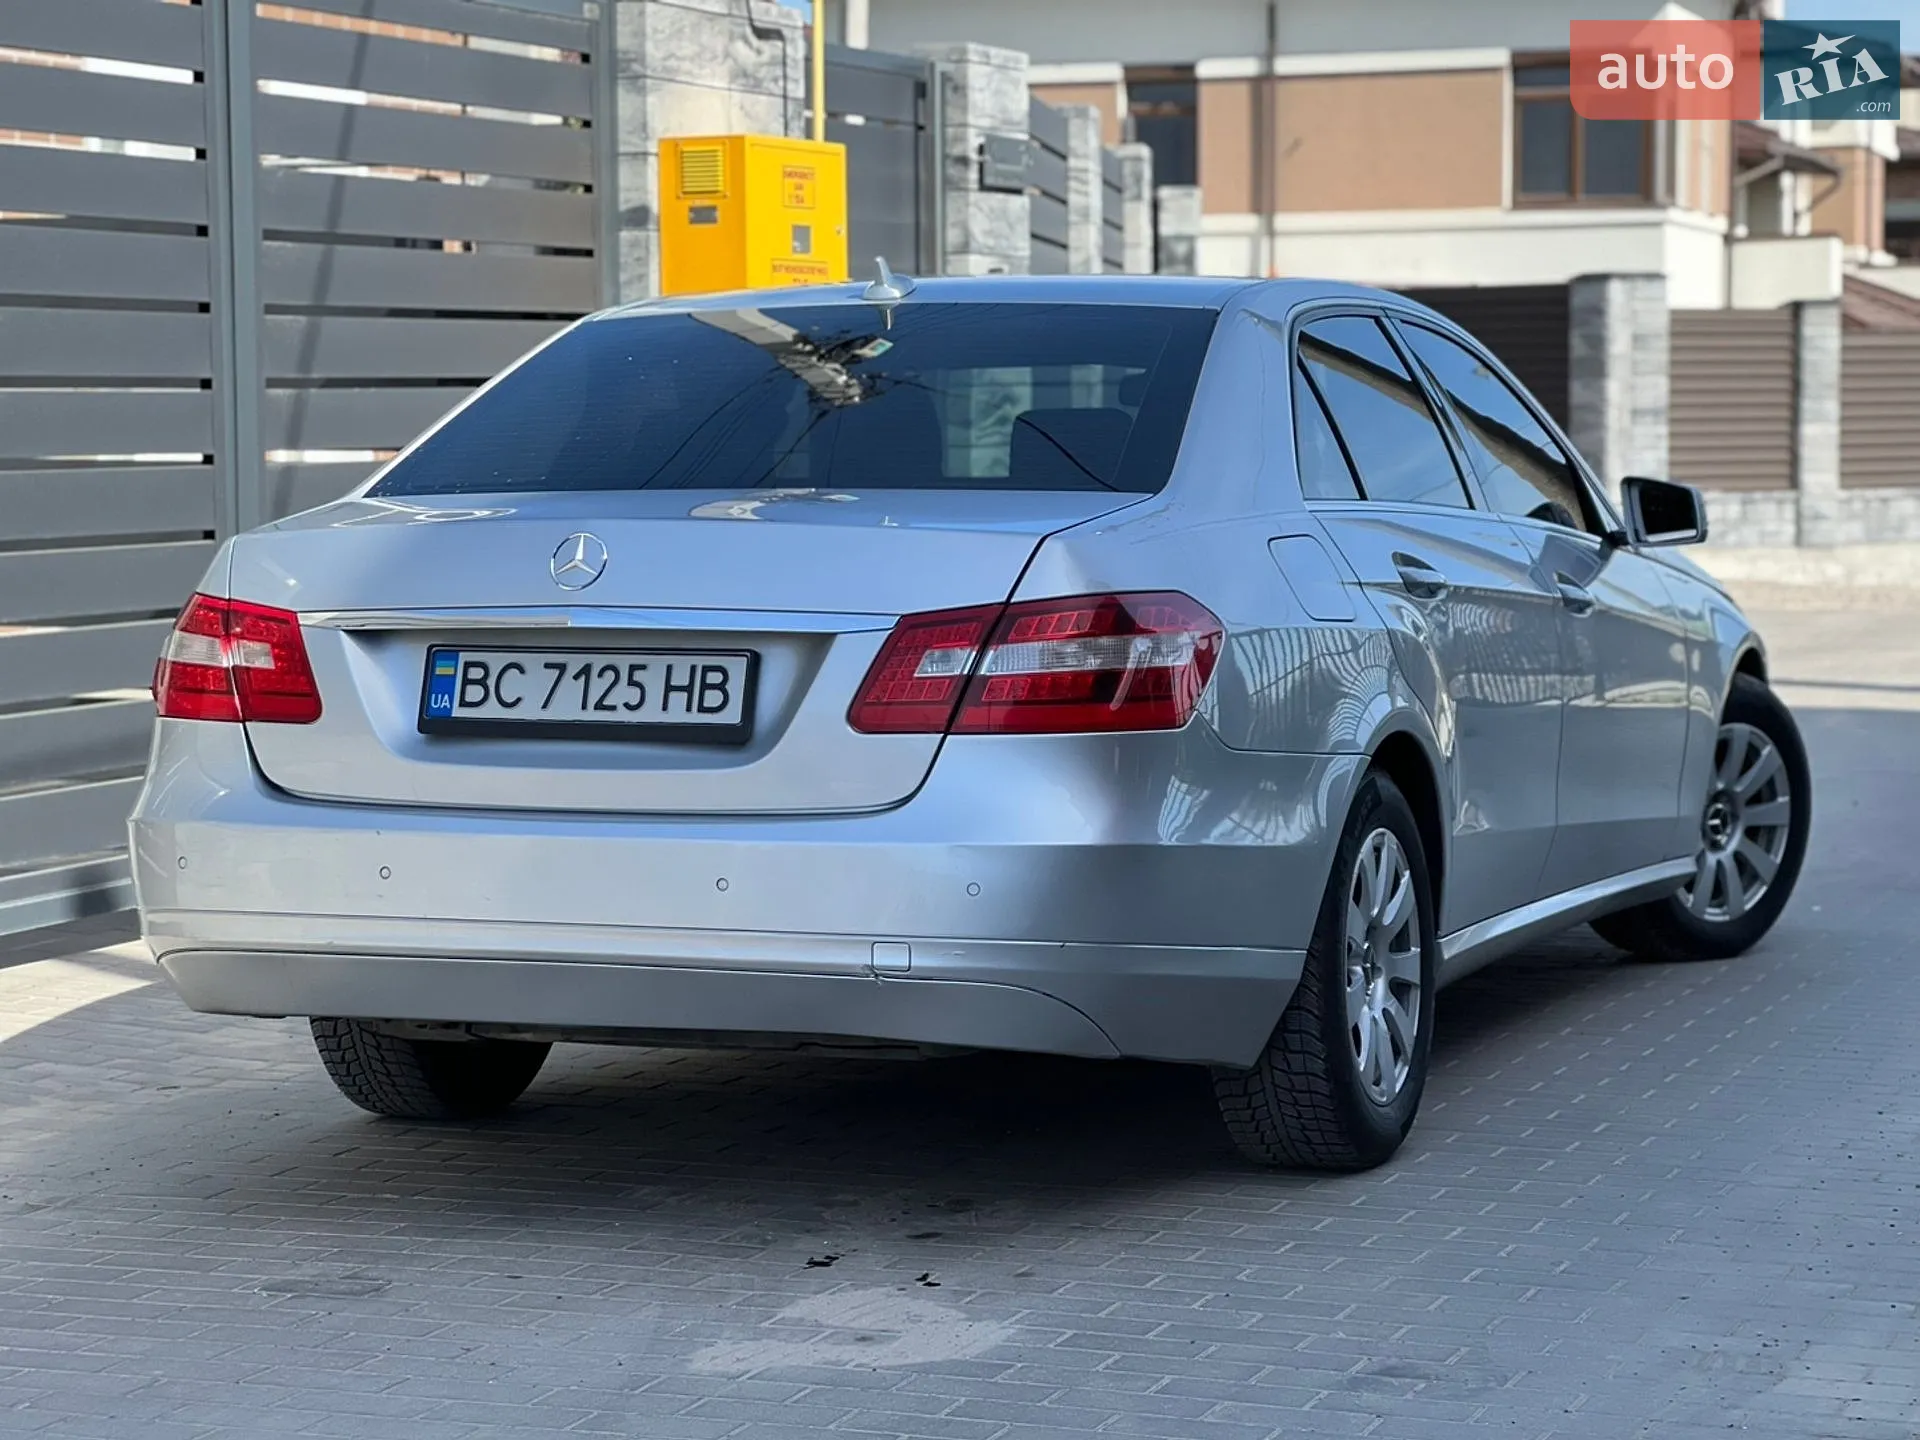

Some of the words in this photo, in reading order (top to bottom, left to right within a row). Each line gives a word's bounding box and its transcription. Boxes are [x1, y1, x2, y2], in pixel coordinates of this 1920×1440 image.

[431, 693, 450, 709] UA
[458, 660, 526, 709] BC
[541, 662, 648, 711] 7125
[661, 663, 730, 714] HB
